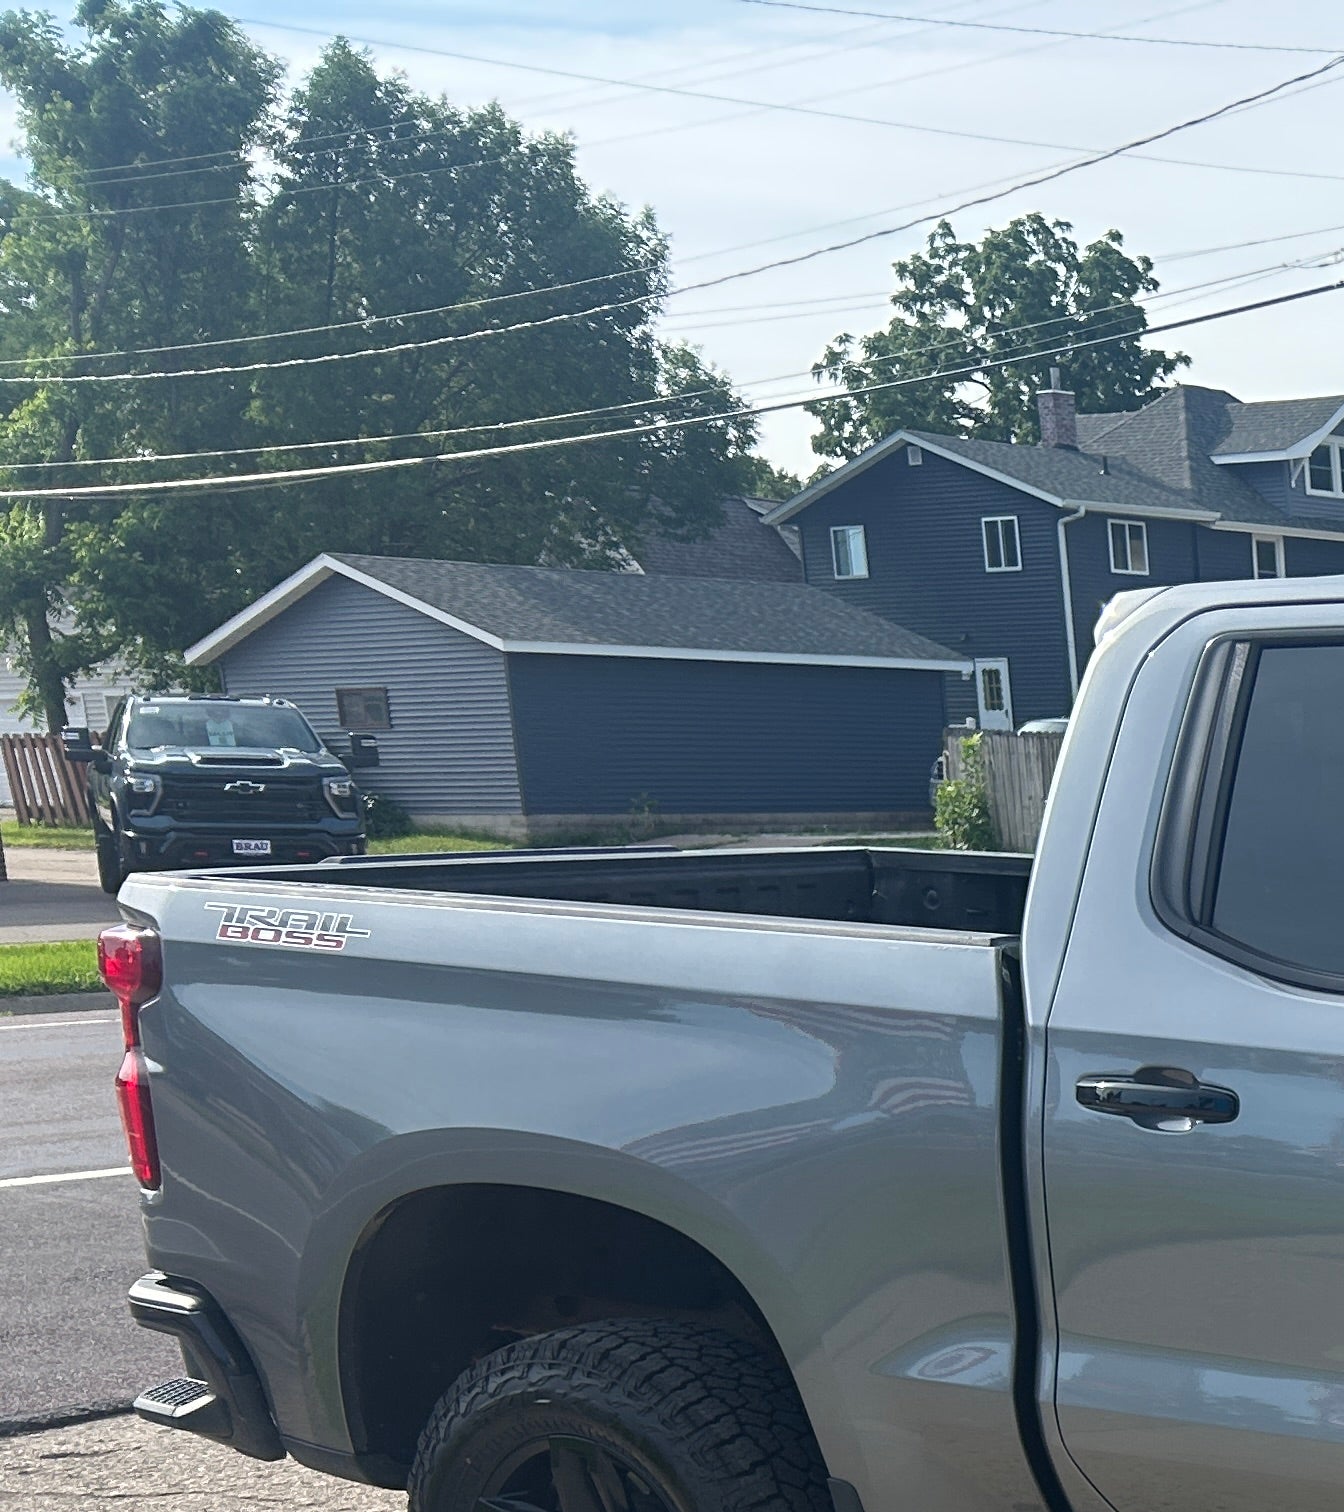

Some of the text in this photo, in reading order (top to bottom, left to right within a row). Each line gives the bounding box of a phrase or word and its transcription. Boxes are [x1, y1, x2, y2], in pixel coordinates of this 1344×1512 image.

[235, 842, 269, 851] BRAU
[204, 902, 371, 938] TRAIL
[216, 922, 346, 951] BOSS
